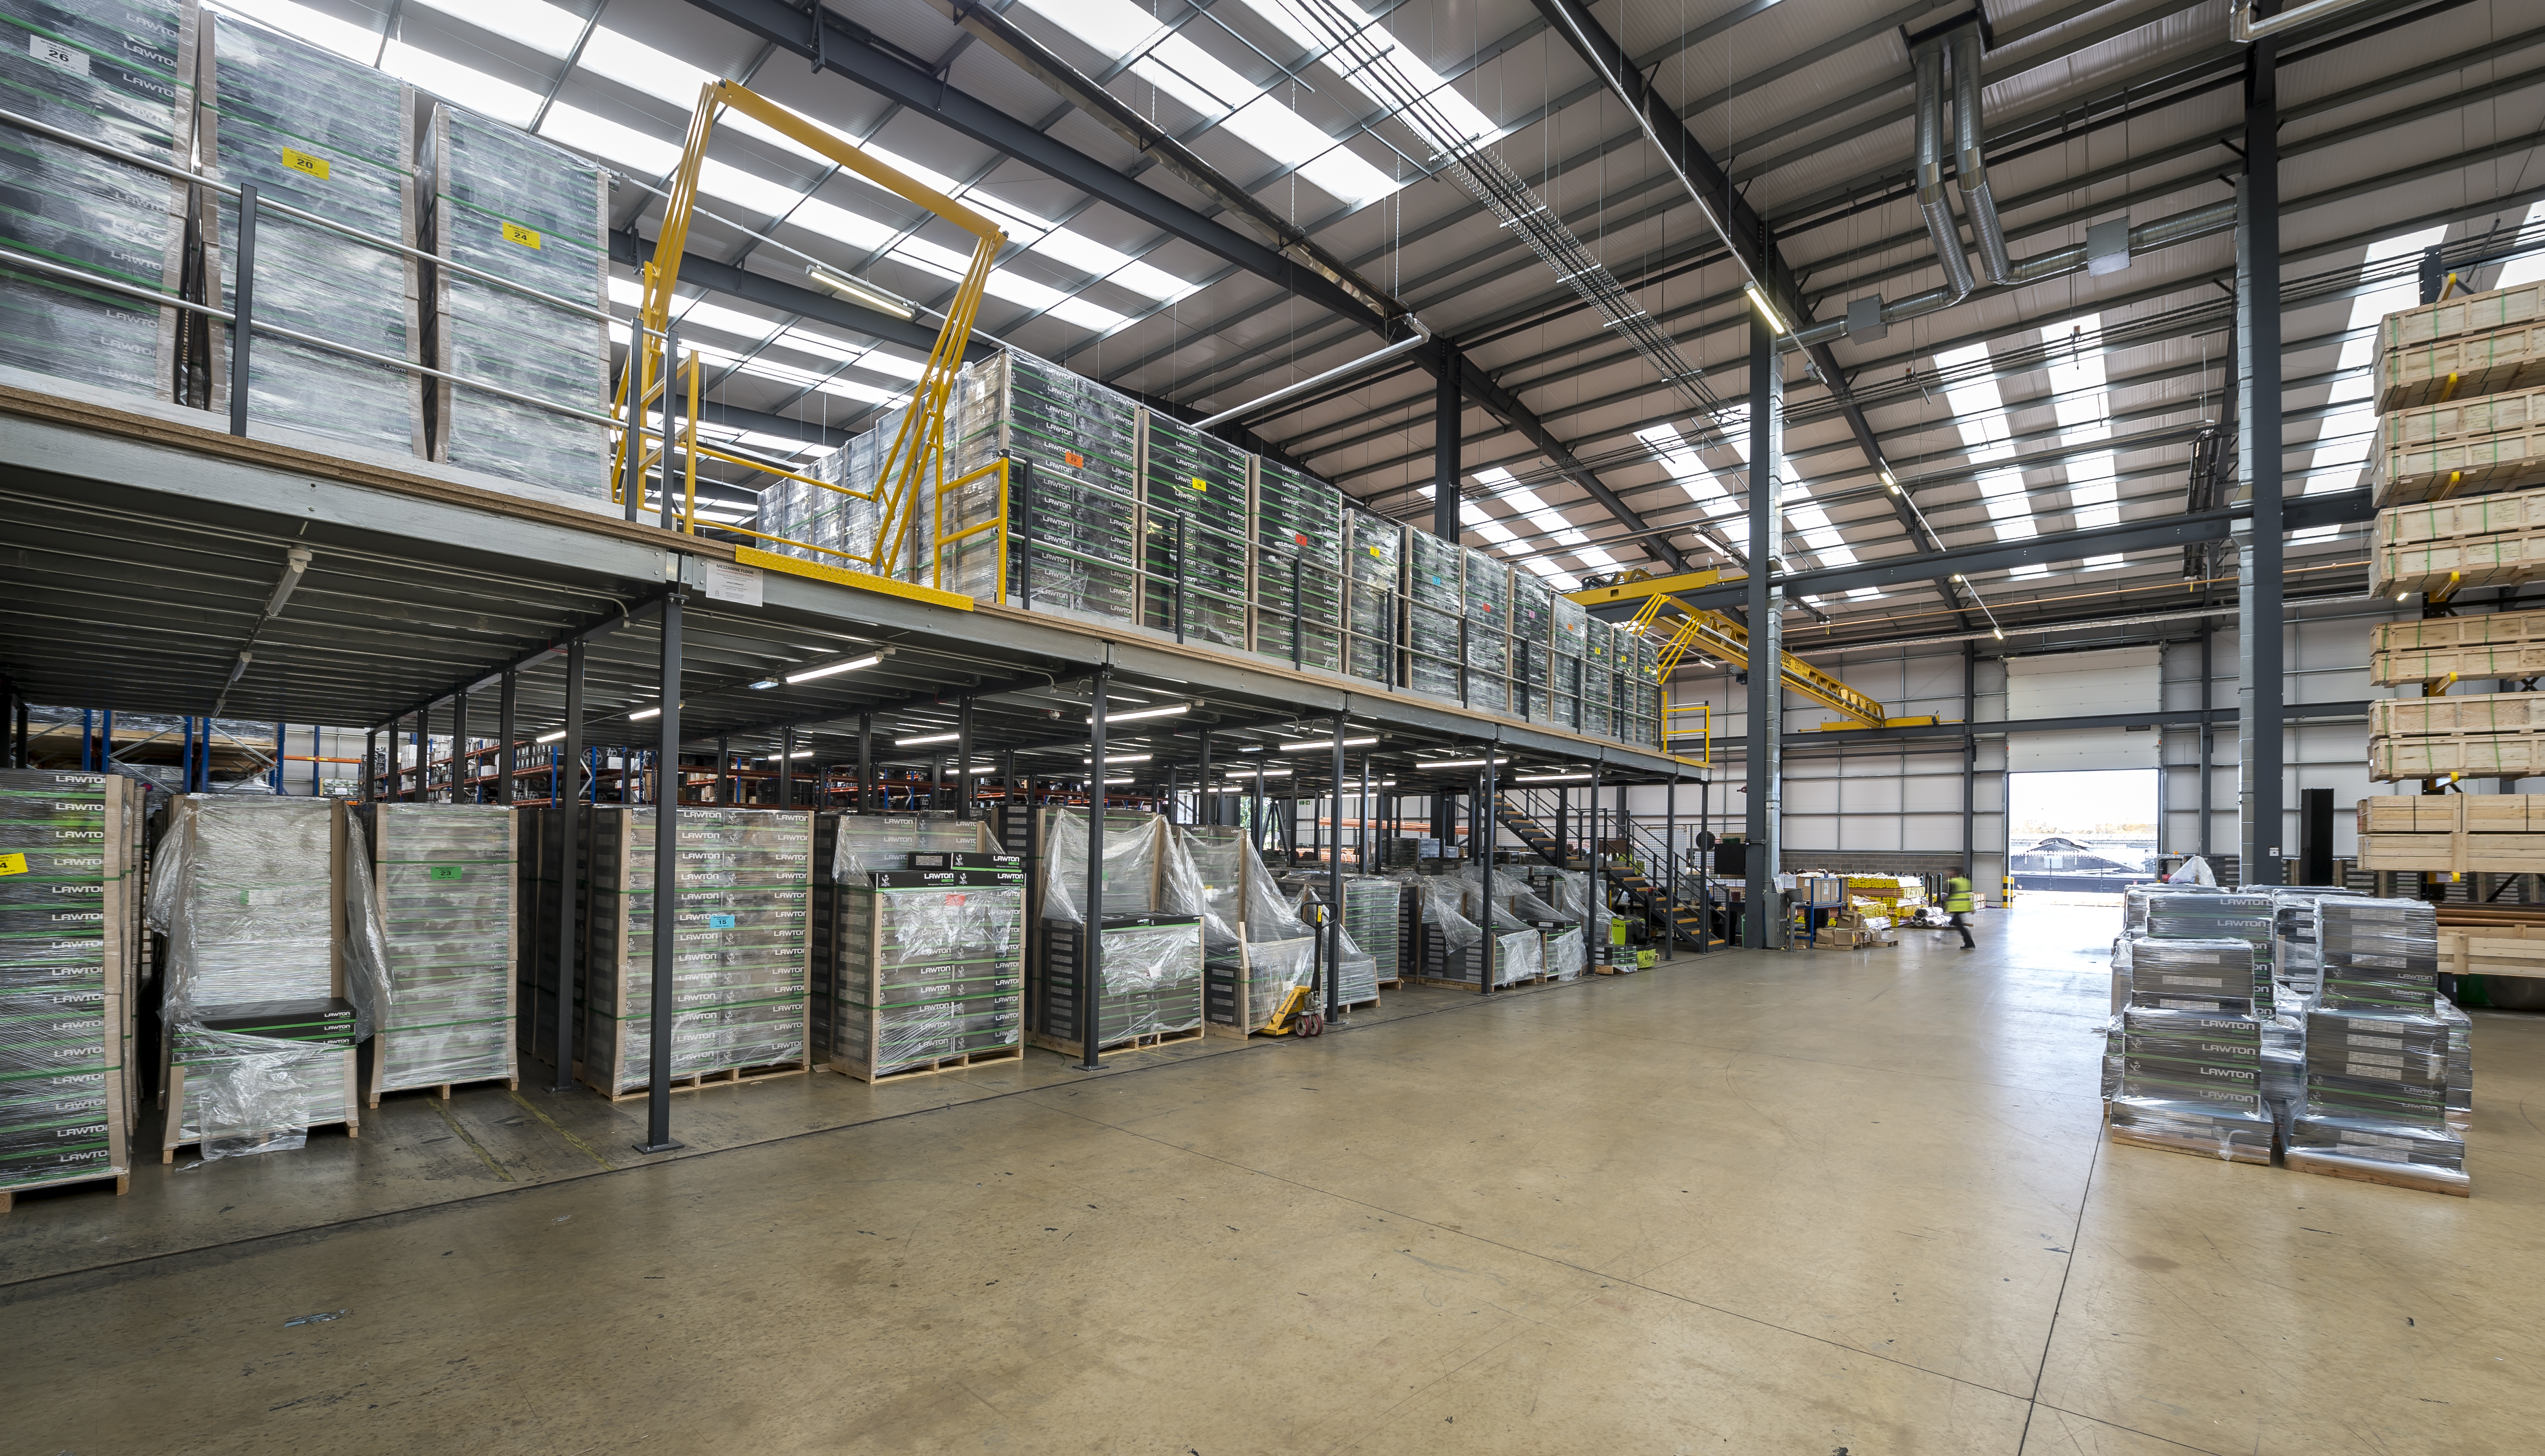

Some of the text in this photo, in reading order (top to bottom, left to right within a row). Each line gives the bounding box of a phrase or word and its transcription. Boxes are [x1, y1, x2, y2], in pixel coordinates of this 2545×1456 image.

[127, 12, 179, 38] LAWTO
[49, 50, 69, 61] 26
[123, 73, 176, 98] LAWTO
[297, 159, 313, 169] 20
[376, 153, 400, 166] LAWTO
[377, 171, 401, 182] LAWTO
[577, 175, 597, 185] LAWTO
[115, 192, 169, 214] LAWTO
[378, 203, 401, 215] LAWTO
[578, 204, 597, 214] LAWTO
[112, 220, 164, 241] LAWTO
[578, 232, 598, 243] LAWTO
[111, 250, 163, 271] LAWTO
[578, 261, 598, 271] LAWTO
[106, 310, 158, 328] LAWTO
[383, 332, 406, 342] LAWTO
[385, 363, 407, 374] LAWTO
[580, 361, 599, 369] LAWTO
[579, 389, 600, 398] LAWTO
[1048, 385, 1074, 400] LAWTON
[1046, 404, 1072, 418] LAWTON
[389, 428, 412, 436] LAWTO
[1046, 422, 1073, 436] LAWTON
[1176, 424, 1198, 437] LAWTON
[1176, 441, 1197, 453] LAWTON
[1046, 460, 1072, 473] LAWTON
[1176, 458, 1197, 469] LAWTON
[1282, 466, 1299, 476] LAWTON
[1044, 478, 1070, 491] LAWTON
[1282, 481, 1300, 492] LAWTON
[1325, 484, 1340, 494] LAWTON
[1175, 490, 1197, 502] LAWTON
[1281, 496, 1298, 506] LAWTON
[1045, 497, 1071, 510] LAWTON
[1043, 515, 1070, 528] LAWTON
[1282, 511, 1299, 521] LAWTON
[1361, 514, 1375, 523] LAWTON
[1044, 534, 1071, 546] LAWTON
[1042, 552, 1069, 564] LAWTON
[1359, 557, 1374, 565] LAWTON
[1045, 569, 1071, 581] LAWTON
[1041, 589, 1068, 599] LAWTON
[1358, 625, 1373, 634] LAWTON
[56, 802, 103, 811] LAWTO
[679, 953, 716, 961] LAWTON
[679, 973, 716, 981] LAWTON
[678, 993, 715, 1002] LAWTON
[920, 1003, 949, 1012] LAWTON
[679, 1012, 717, 1021] LAWTON
[2201, 1019, 2255, 1030] LAWTON
[677, 1033, 715, 1042] LAWTON
[2202, 1043, 2255, 1055] LAWTON
[2201, 1067, 2254, 1079] LAWTON
[2200, 1090, 2253, 1103] LAWTON
[2404, 1087, 2440, 1095] LAWTON
[60, 1150, 109, 1162] LAWTO
